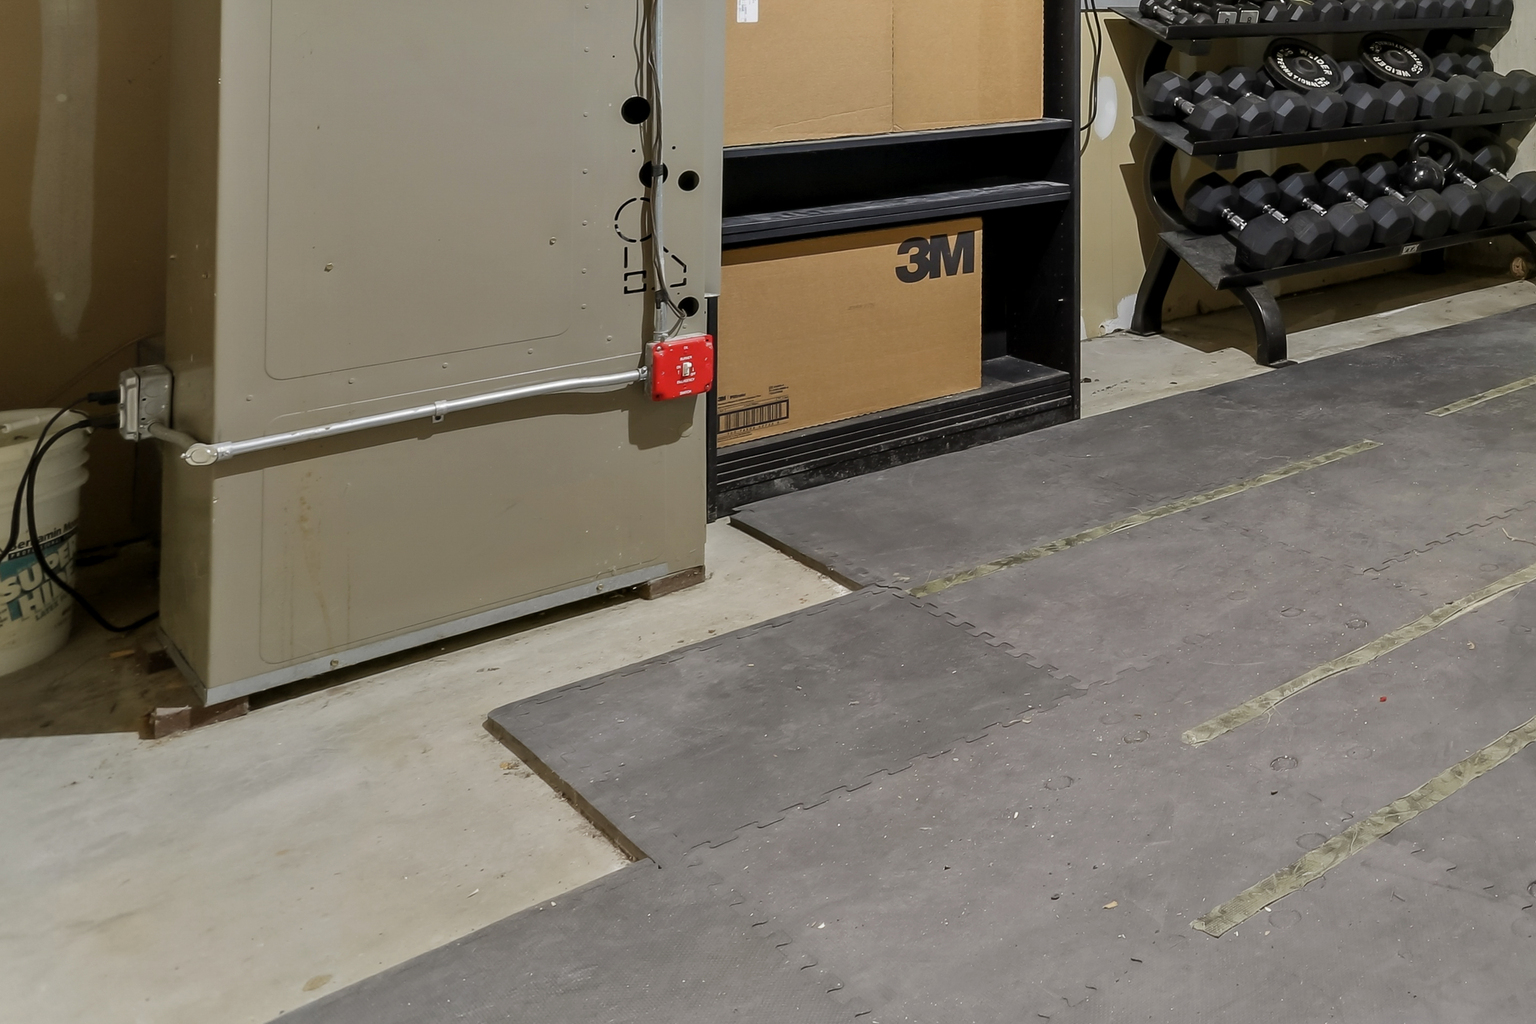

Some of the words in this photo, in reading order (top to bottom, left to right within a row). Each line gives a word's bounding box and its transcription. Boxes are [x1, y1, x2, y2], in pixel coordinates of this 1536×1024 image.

[1299, 48, 1333, 76] WEIDER
[1372, 56, 1411, 77] WEIDER
[895, 230, 975, 284] 3M
